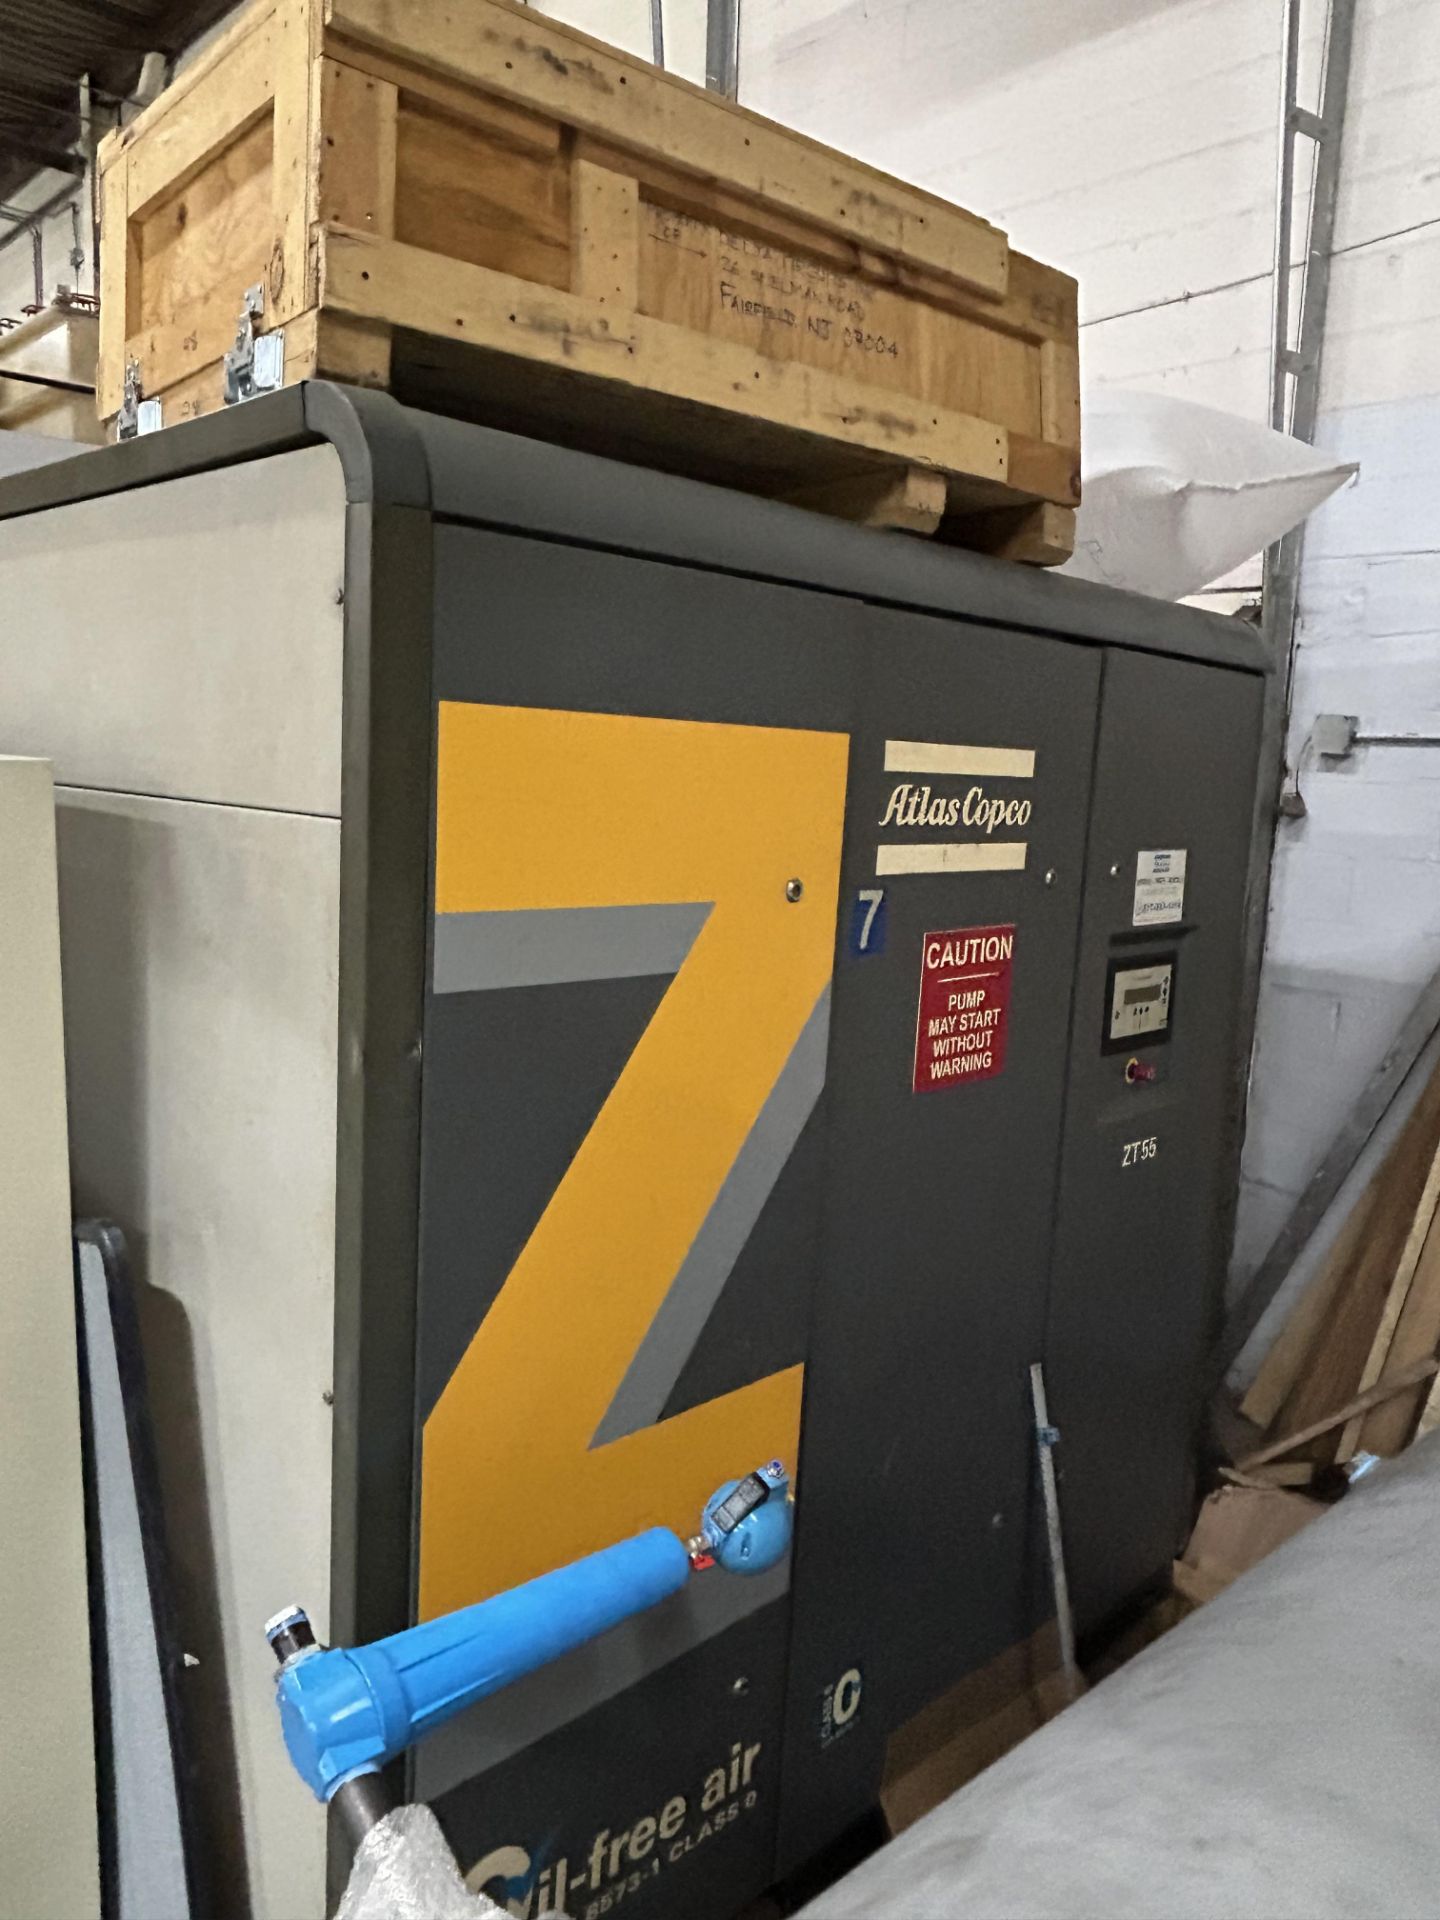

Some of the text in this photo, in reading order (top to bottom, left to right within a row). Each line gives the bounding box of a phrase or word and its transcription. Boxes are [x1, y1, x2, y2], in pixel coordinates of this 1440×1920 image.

[878, 783, 1032, 834] Atlas Copco
[859, 889, 884, 950] 7
[926, 935, 1013, 970] CAUTION
[948, 990, 986, 1012] PUMP
[928, 1008, 1001, 1037] MAY START
[932, 1030, 993, 1058] WITHOUT
[929, 1051, 993, 1080] WARNING
[702, 1741, 761, 1812] air
[668, 1802, 740, 1863] CLASS
